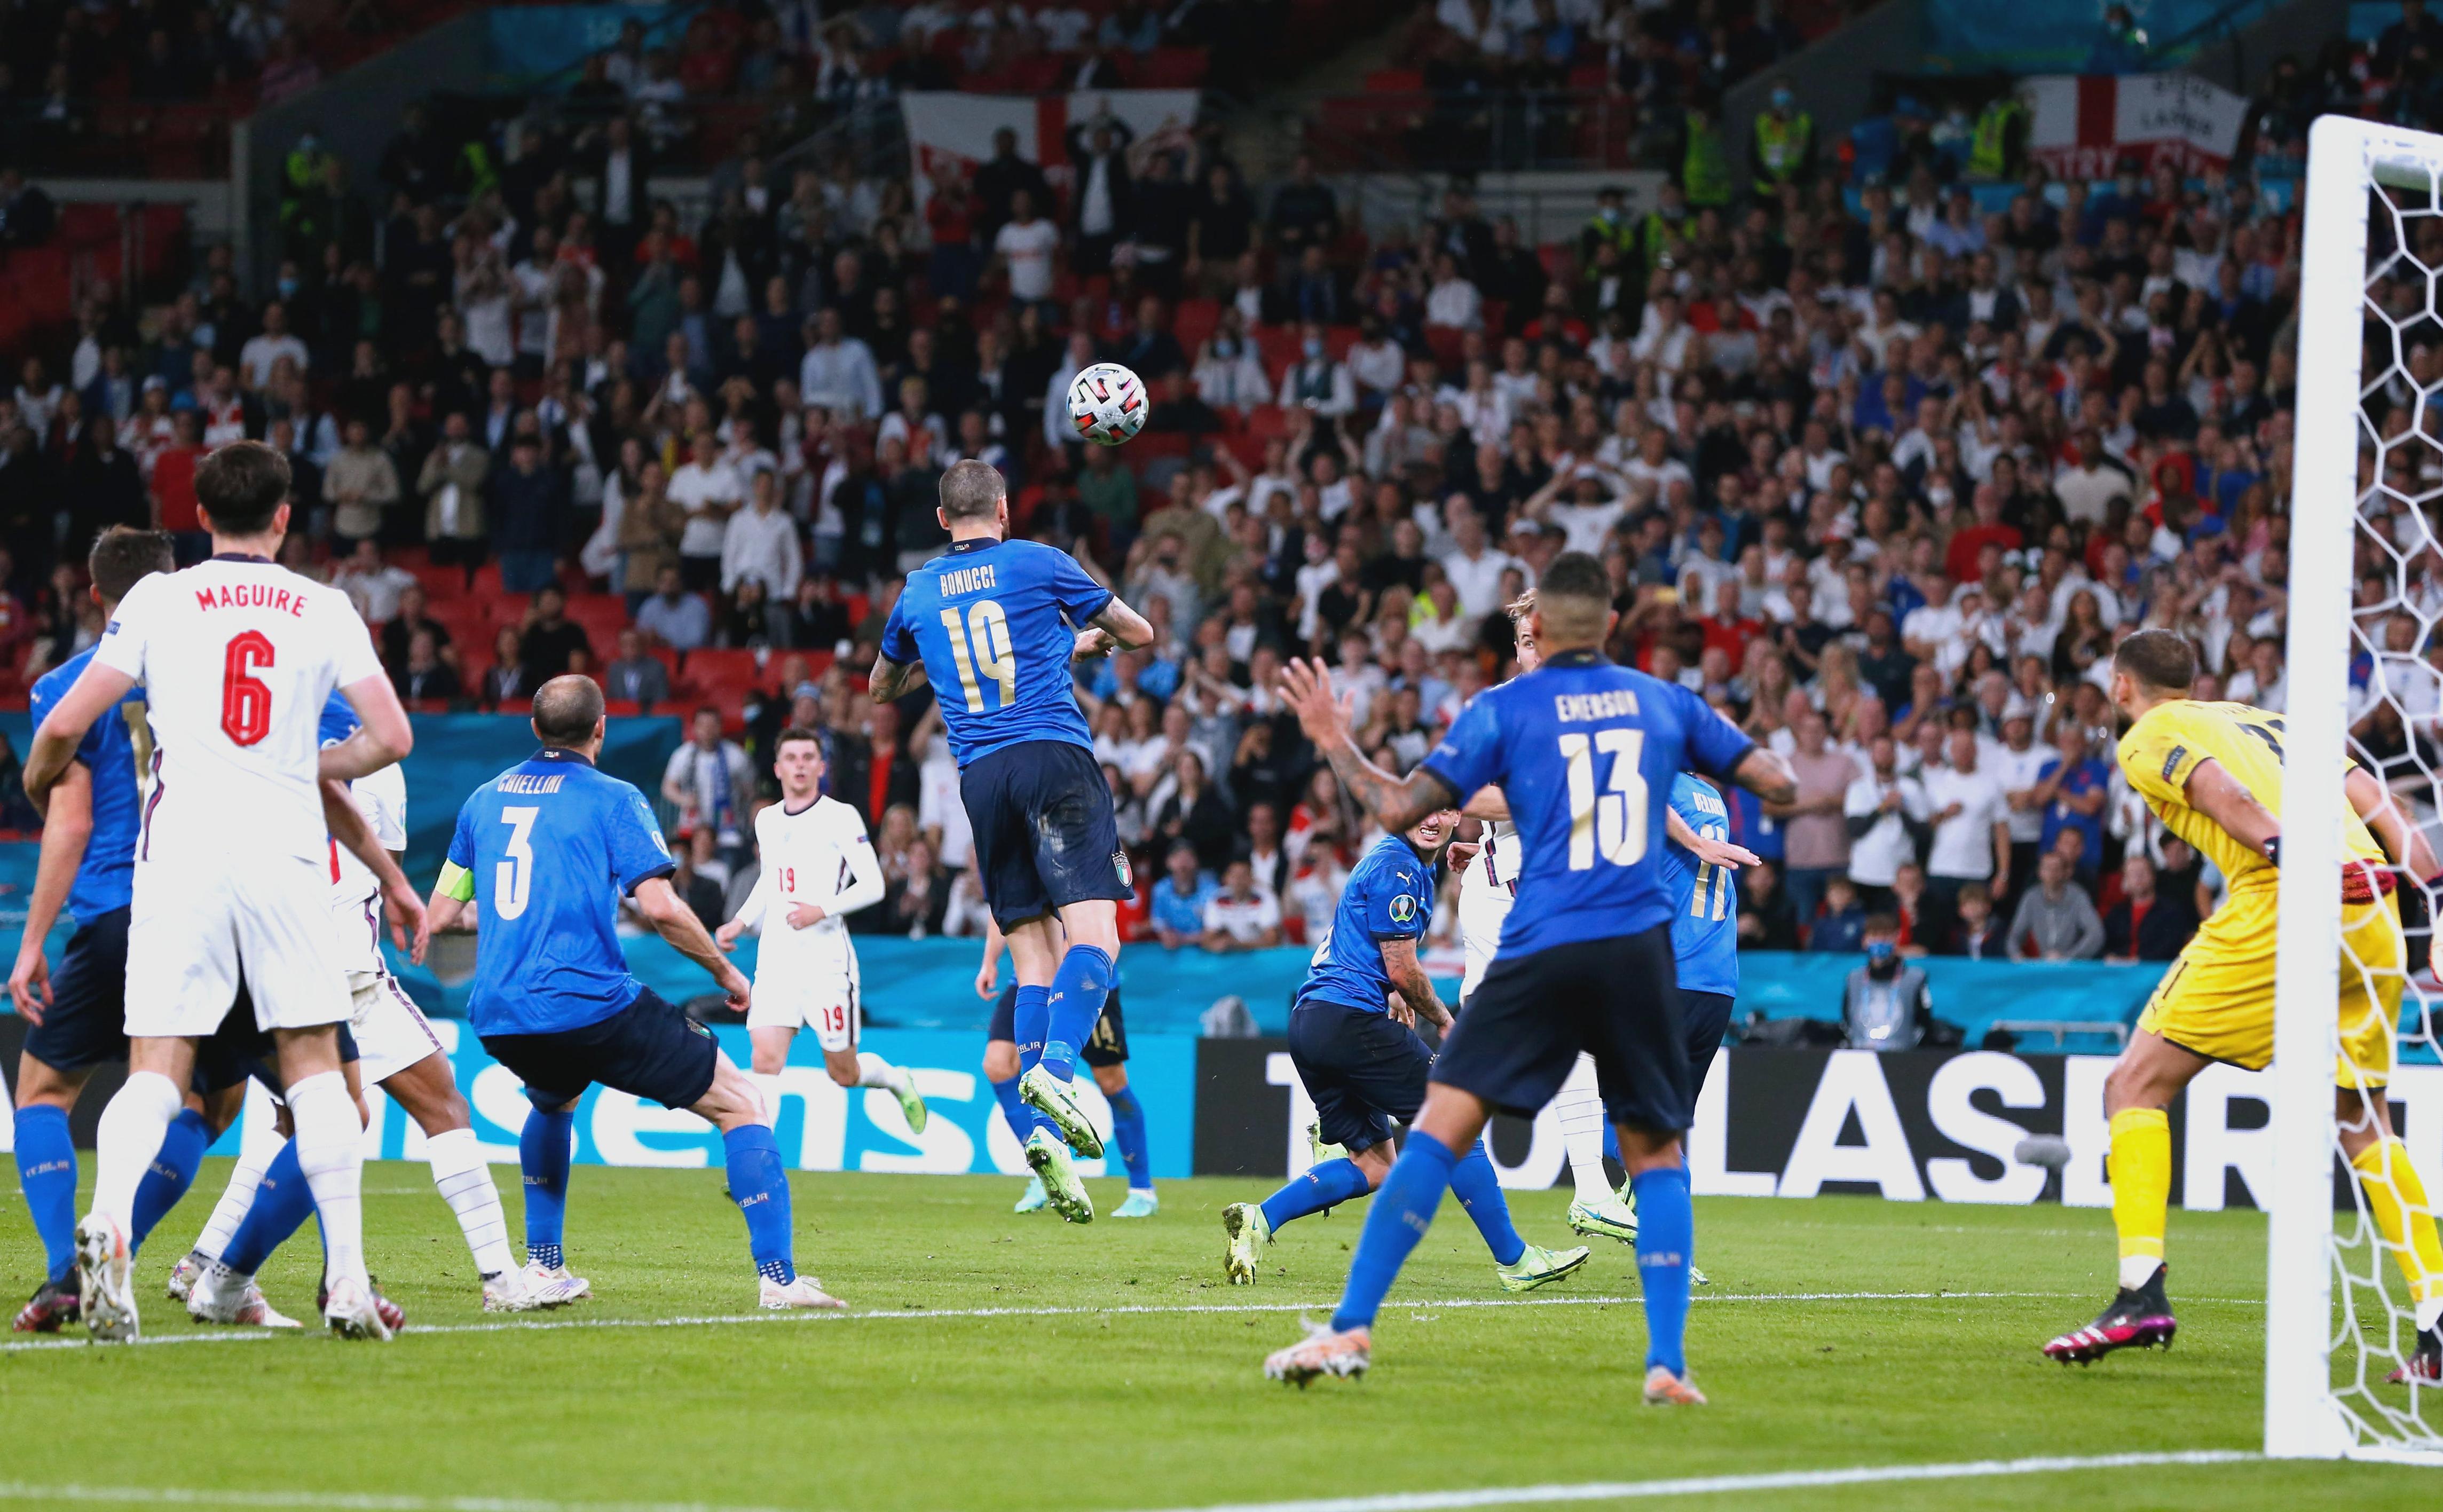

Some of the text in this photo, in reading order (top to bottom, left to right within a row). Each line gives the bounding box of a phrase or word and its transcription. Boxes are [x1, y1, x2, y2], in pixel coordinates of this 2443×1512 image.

[195, 584, 308, 617] MAGUIRE
[940, 564, 996, 597] BONUCCI
[220, 629, 275, 746] 6
[940, 600, 1016, 713] 19
[1555, 689, 1640, 722] EMERSON
[497, 775, 566, 794] CHIELLINI
[1558, 728, 1649, 872] 13
[495, 806, 539, 920] 3
[779, 868, 794, 893] 19
[1690, 824, 1726, 921] 11
[823, 1005, 844, 1031] 19
[1687, 1046, 2275, 1212] LASER
